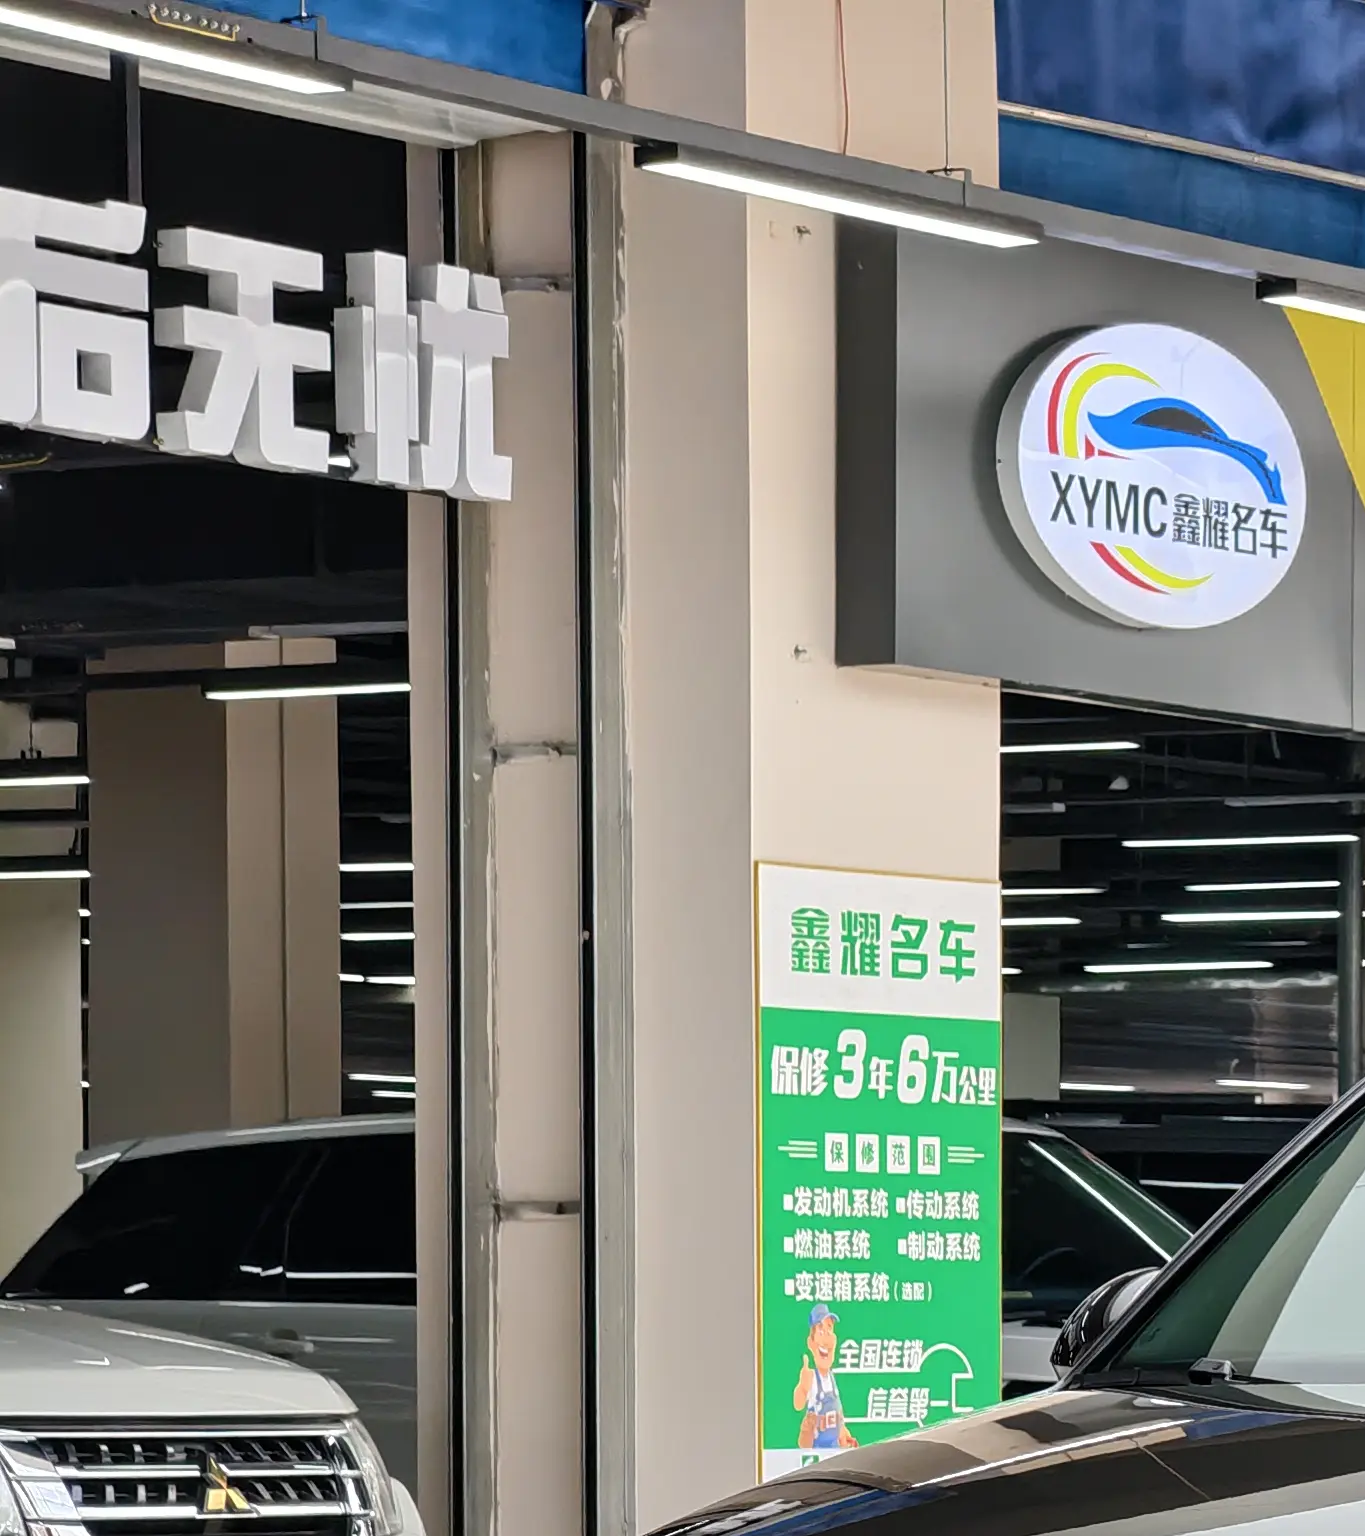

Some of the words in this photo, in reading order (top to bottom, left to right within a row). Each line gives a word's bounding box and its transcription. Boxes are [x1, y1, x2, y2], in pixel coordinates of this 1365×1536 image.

[1050, 470, 1168, 539] XYMC
[1171, 492, 1288, 559] 鑫耀名车
[791, 907, 976, 984] 鑫耀名车
[771, 1028, 997, 1106] 保修3年6万公里
[829, 1140, 937, 1168] 保修范围
[793, 1186, 889, 1219] 发动机系统
[906, 1189, 980, 1221] 传动系统
[793, 1228, 871, 1260] 燃油系统
[906, 1231, 981, 1262] 制动系统
[838, 1338, 924, 1371] 全国连锁
[867, 1387, 949, 1421] 信誉第一
